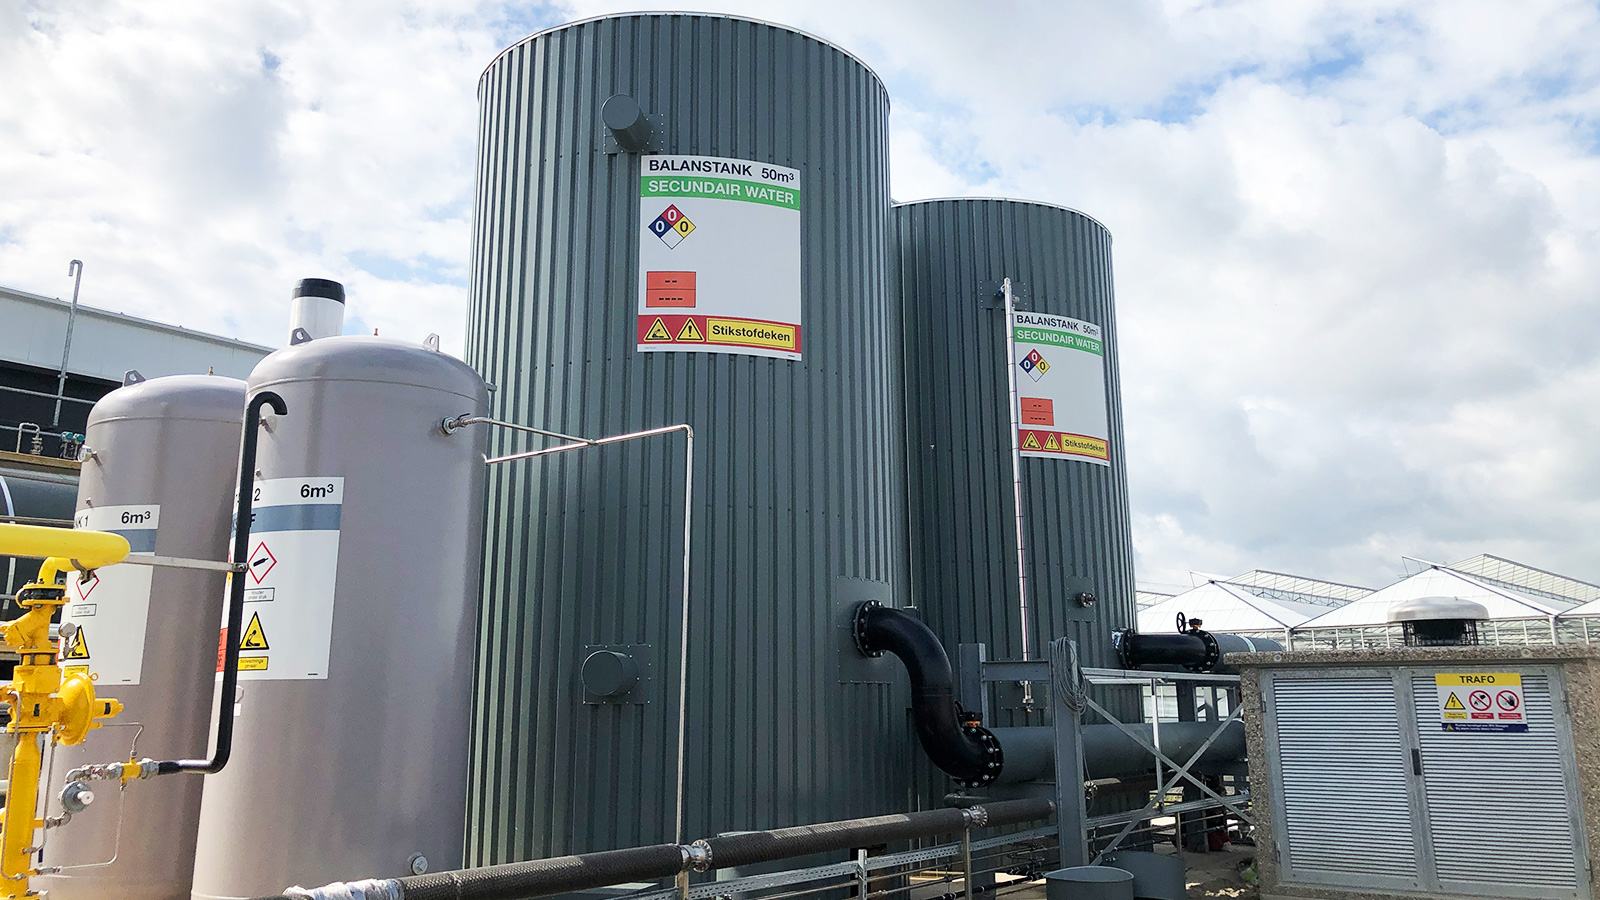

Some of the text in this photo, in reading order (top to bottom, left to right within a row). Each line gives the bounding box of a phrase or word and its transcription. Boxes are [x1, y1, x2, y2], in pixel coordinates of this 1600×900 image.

[649, 159, 752, 177] BALANSTANK
[648, 180, 794, 205] SECUNDAIR WATER
[667, 209, 677, 222] 0
[655, 220, 689, 233] 0 0
[1016, 314, 1079, 331] BALANSTANK
[712, 324, 791, 342] Stikstofdeken
[1017, 329, 1100, 352] SECUNDAIR WATER
[1459, 675, 1496, 684] TRAFO
